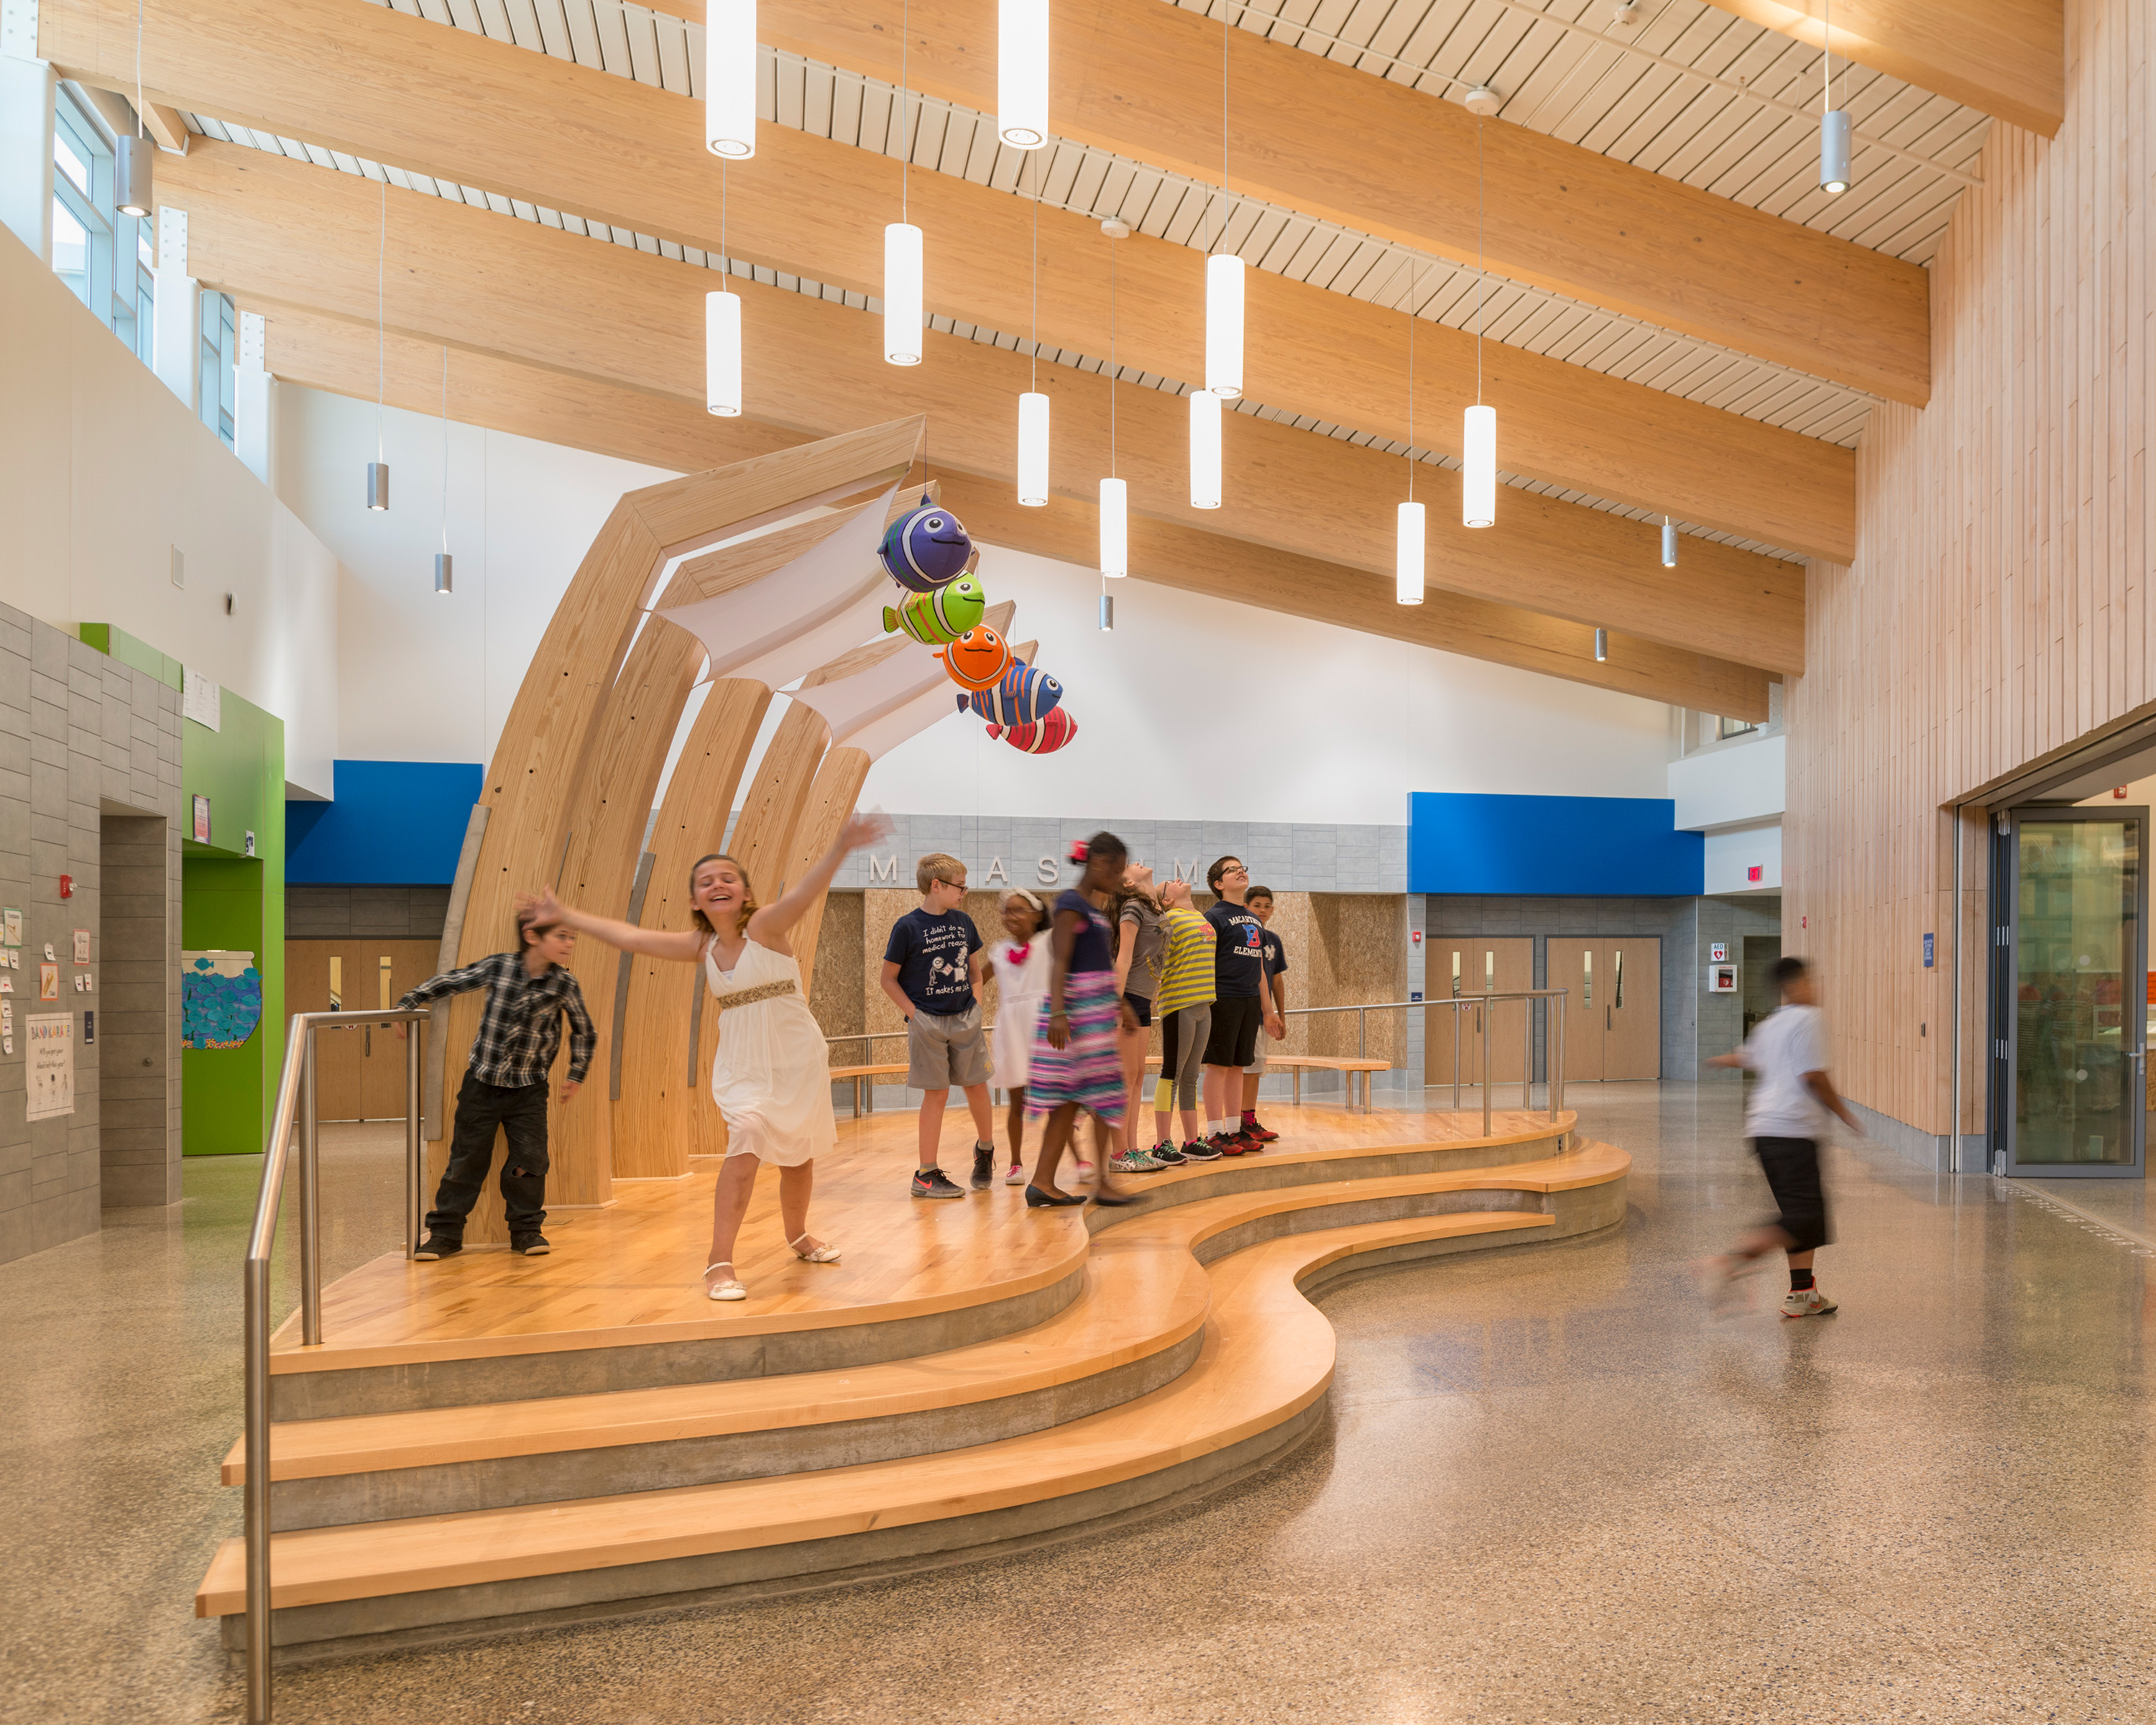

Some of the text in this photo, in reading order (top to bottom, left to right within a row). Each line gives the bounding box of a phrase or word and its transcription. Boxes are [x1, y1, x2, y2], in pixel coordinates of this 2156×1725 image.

[923, 929, 929, 937] I
[930, 925, 946, 934] didn't
[1242, 924, 1261, 947] B
[926, 932, 955, 944] homework
[922, 941, 946, 954] medical
[935, 985, 954, 994] makes
[31, 1024, 70, 1040] BAND KARATE
